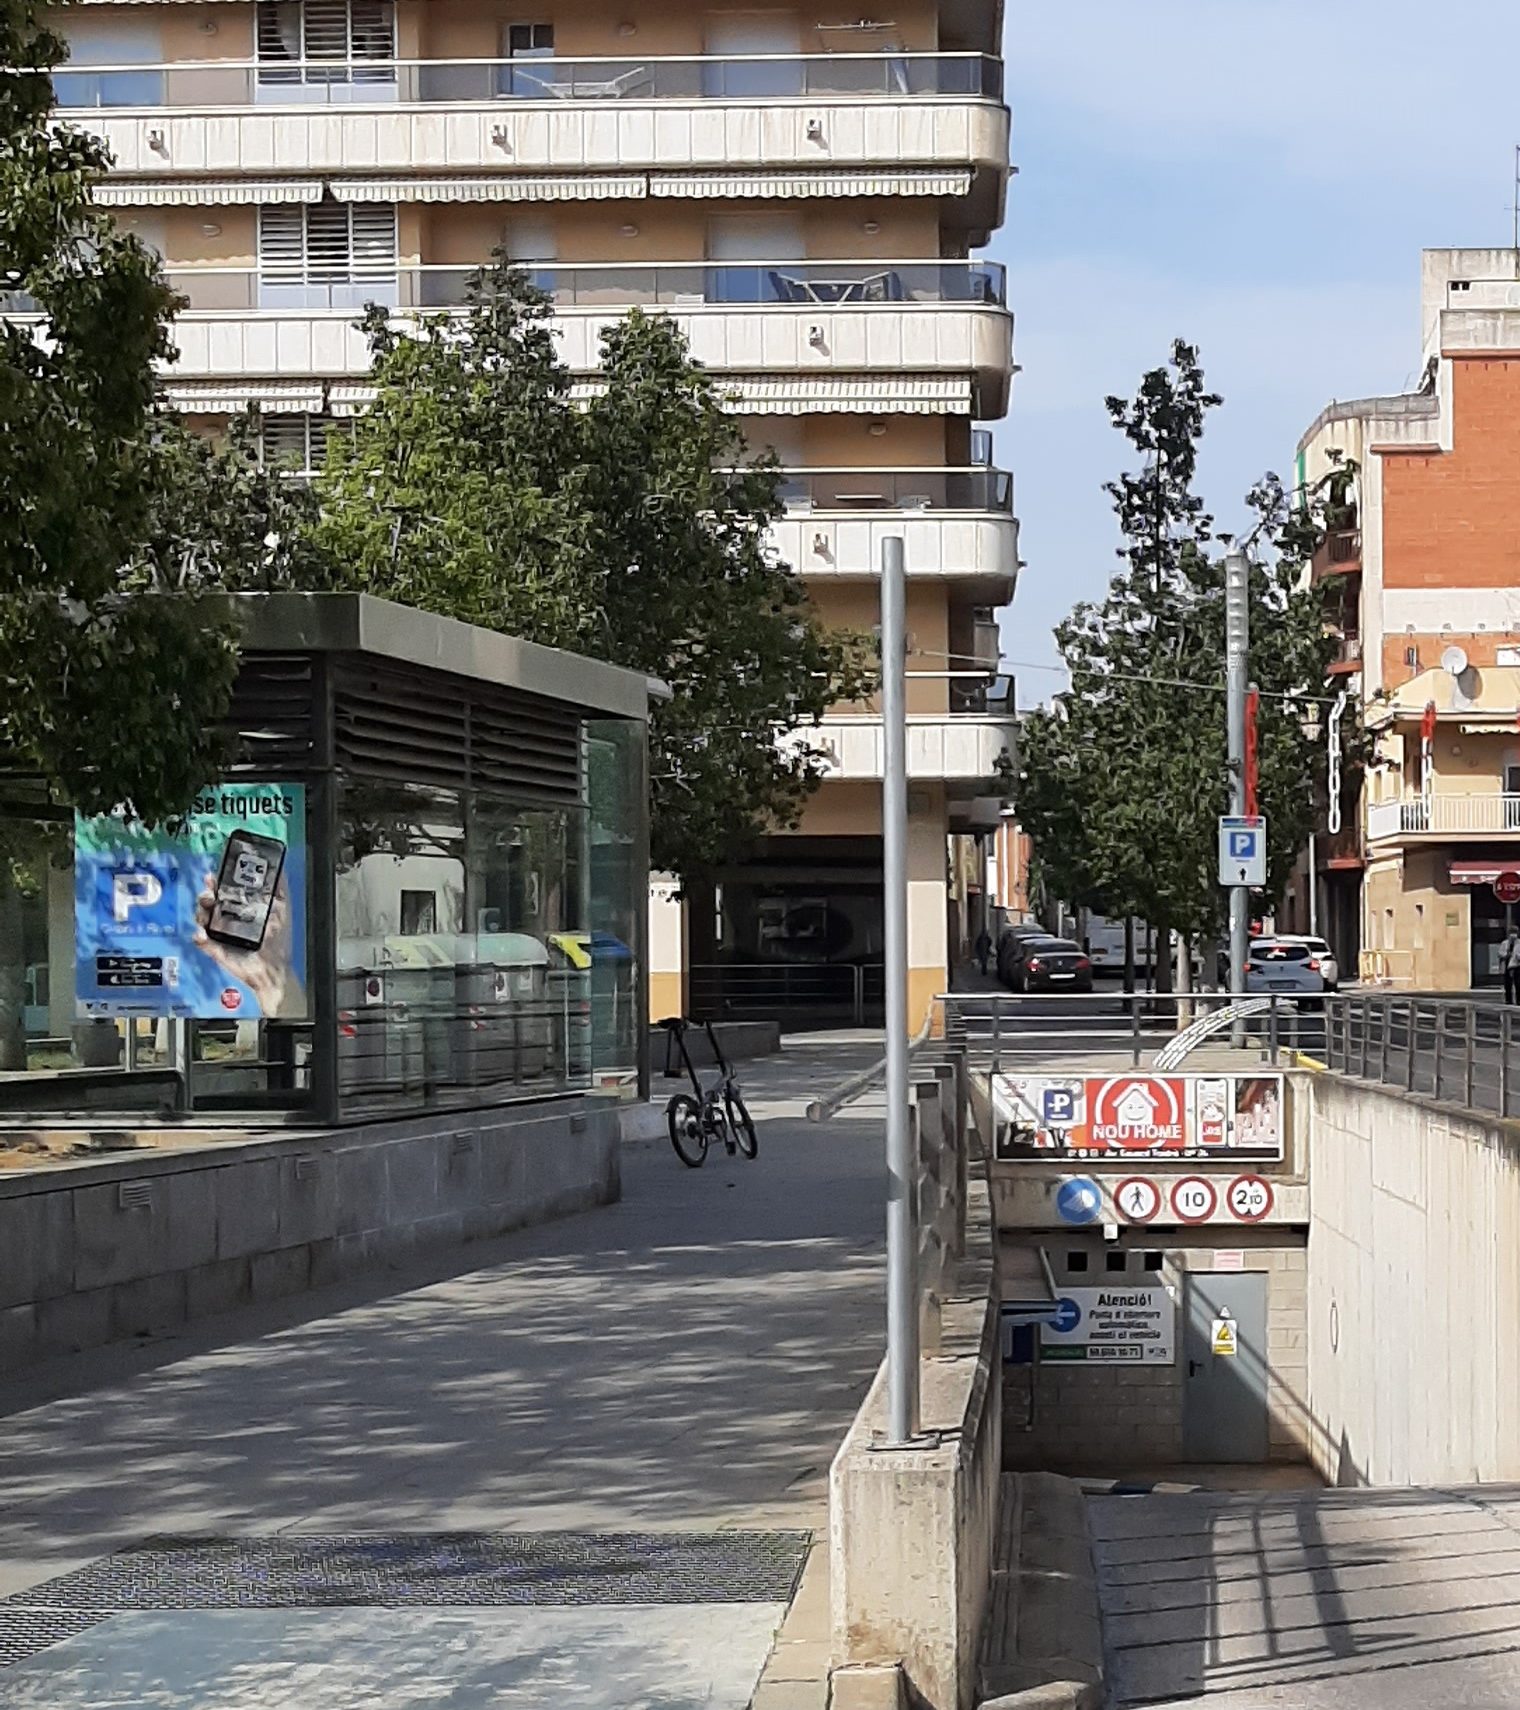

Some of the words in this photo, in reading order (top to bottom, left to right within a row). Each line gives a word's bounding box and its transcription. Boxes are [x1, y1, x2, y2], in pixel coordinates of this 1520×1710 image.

[221, 792, 294, 820] tiquets
[1235, 834, 1252, 855] P
[113, 873, 163, 922] P
[1093, 1124, 1130, 1140] NOU
[1133, 1124, 1183, 1139] HOME
[1185, 1192, 1206, 1207] 10
